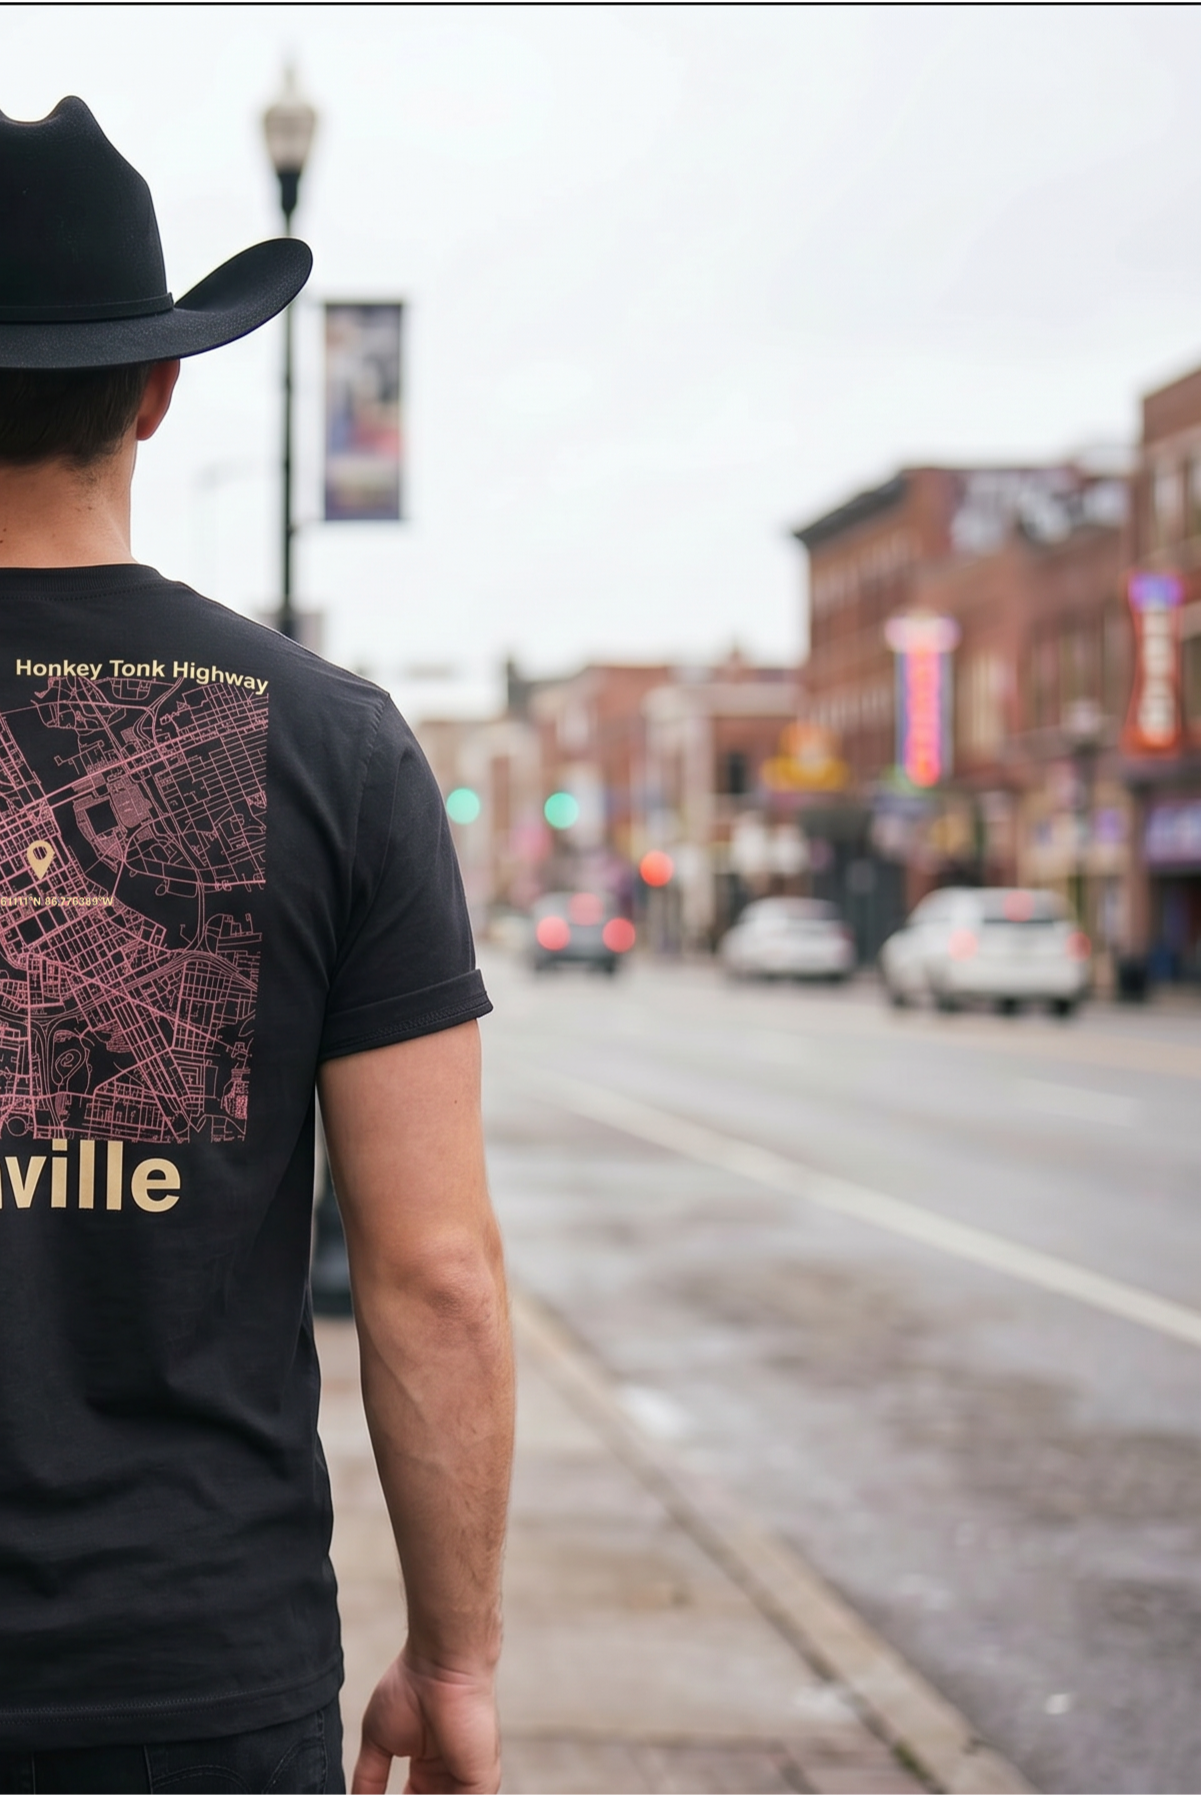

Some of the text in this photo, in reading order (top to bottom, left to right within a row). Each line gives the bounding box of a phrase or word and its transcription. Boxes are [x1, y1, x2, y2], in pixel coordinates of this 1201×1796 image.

[16, 659, 269, 695] Honkey Tonk Highway
